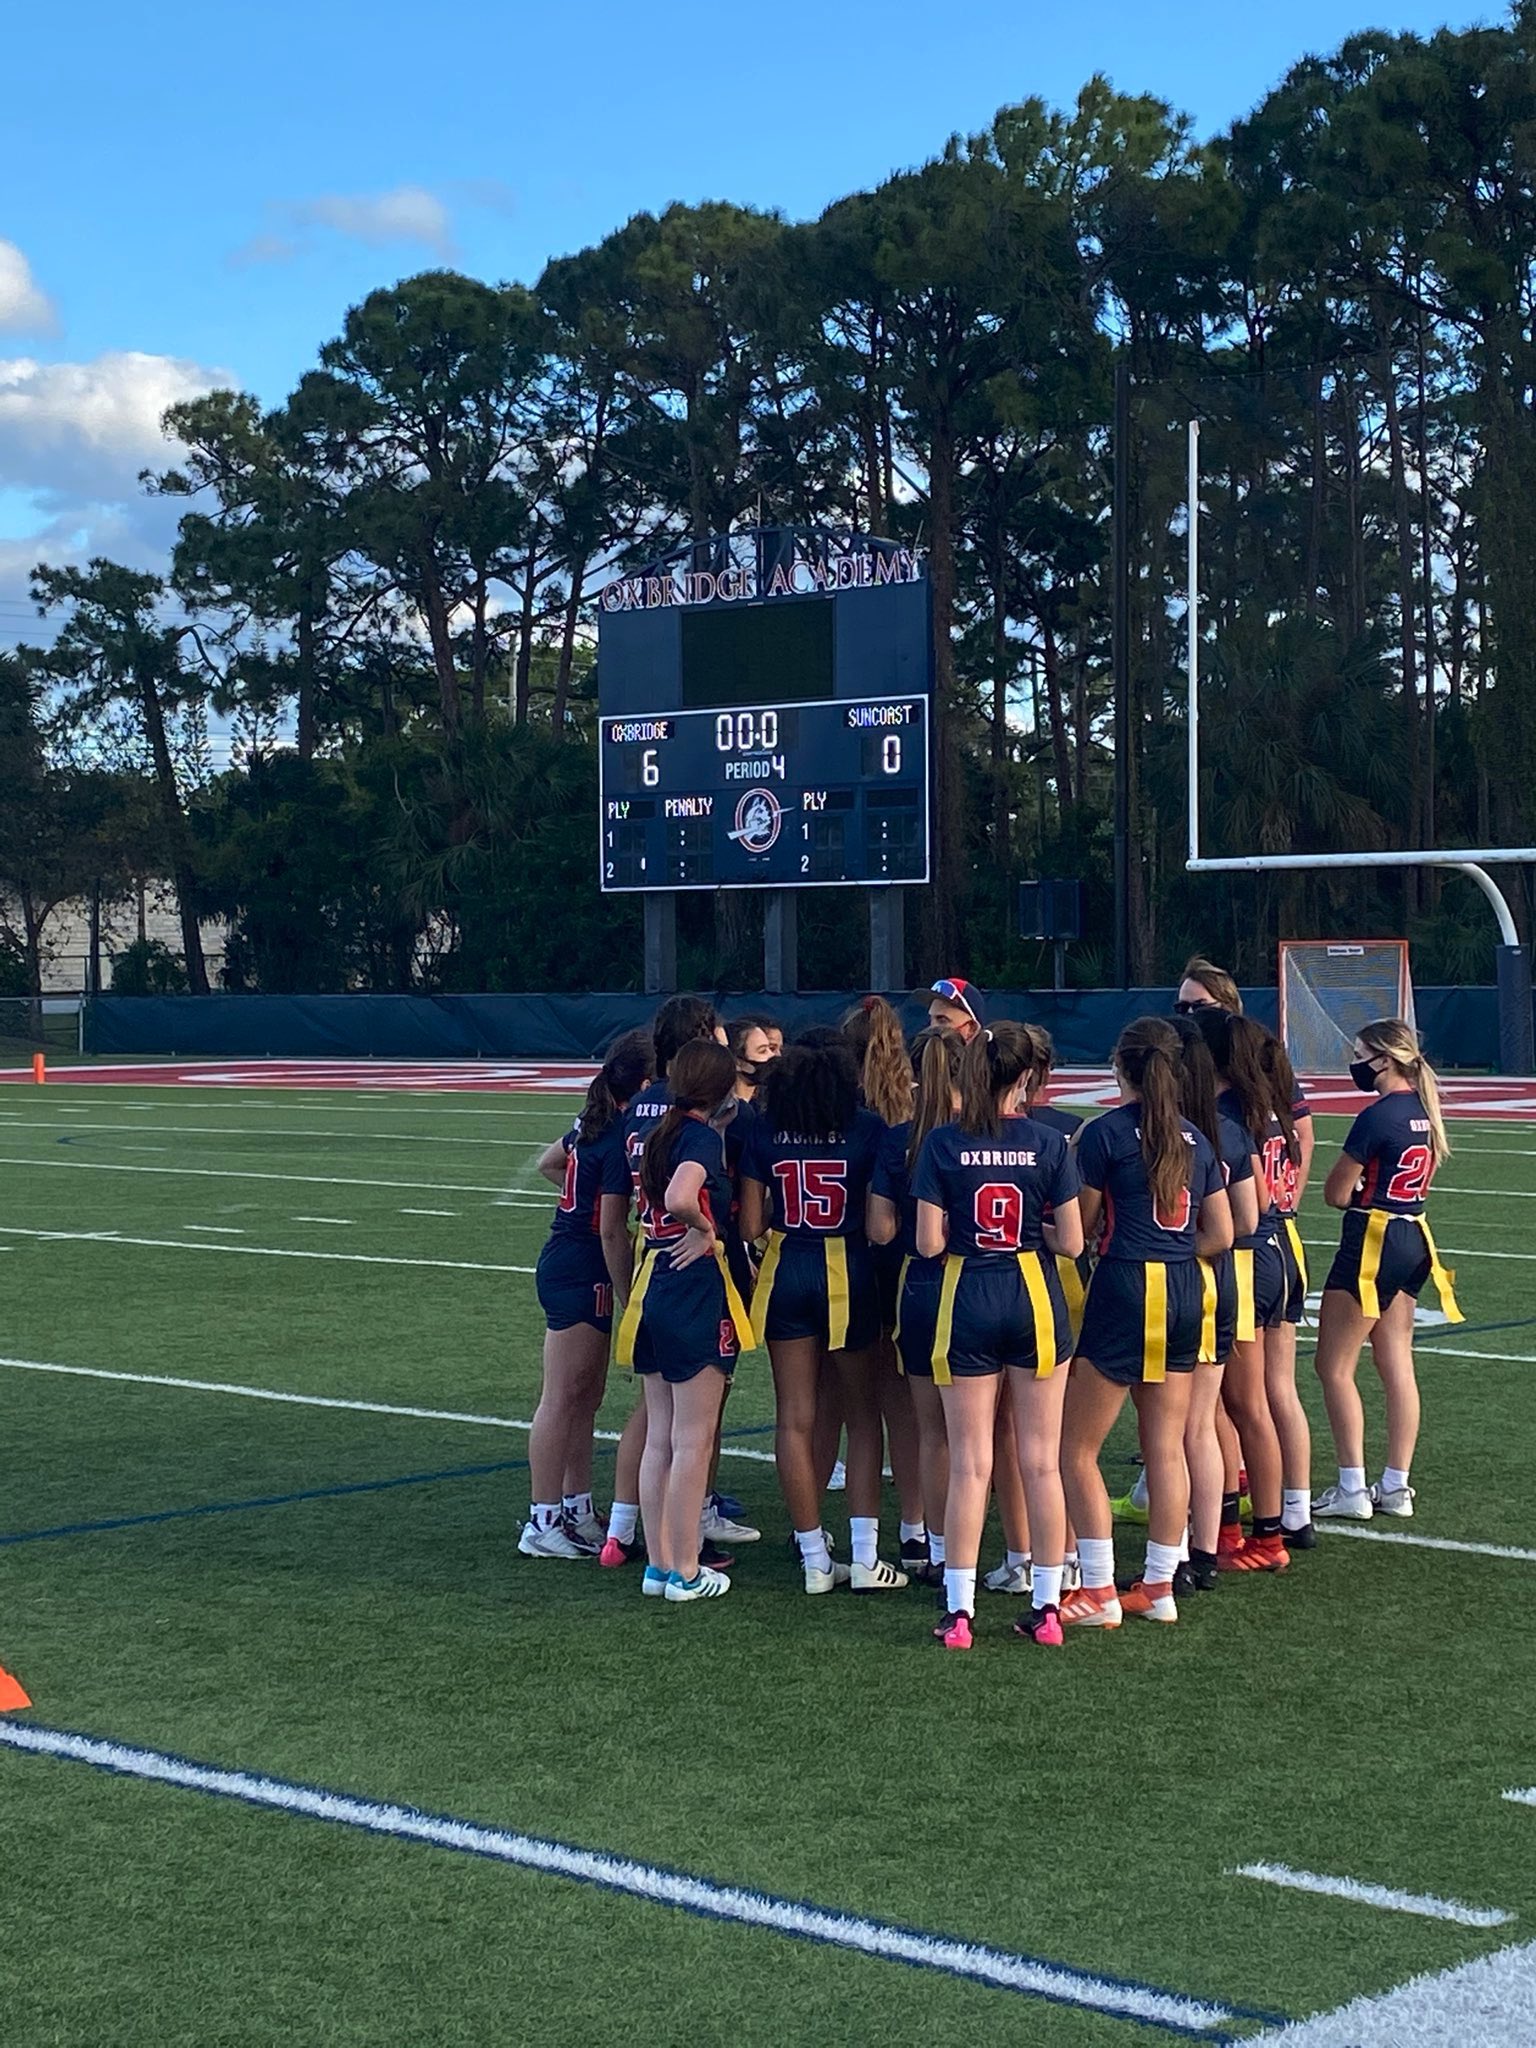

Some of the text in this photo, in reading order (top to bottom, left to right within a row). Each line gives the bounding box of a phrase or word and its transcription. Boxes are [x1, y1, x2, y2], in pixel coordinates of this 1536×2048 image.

[602, 549, 924, 613] OXBRIDGE ACADEMY
[848, 704, 913, 728] SUNCOAST
[611, 721, 669, 742] OXBRIDGE
[716, 711, 778, 751] 00.0
[882, 735, 902, 774] 0
[643, 749, 660, 786] 6
[725, 754, 785, 780] PERIOD 4
[608, 796, 713, 819] PLY PENALTY
[803, 791, 827, 811] PLY
[606, 830, 614, 848] 1
[801, 822, 809, 840] 1
[606, 861, 615, 879] 2
[801, 855, 810, 873] 2
[960, 1150, 1037, 1167] OXBRIDGE
[771, 1159, 848, 1230] 15
[974, 1182, 1024, 1252] 9
